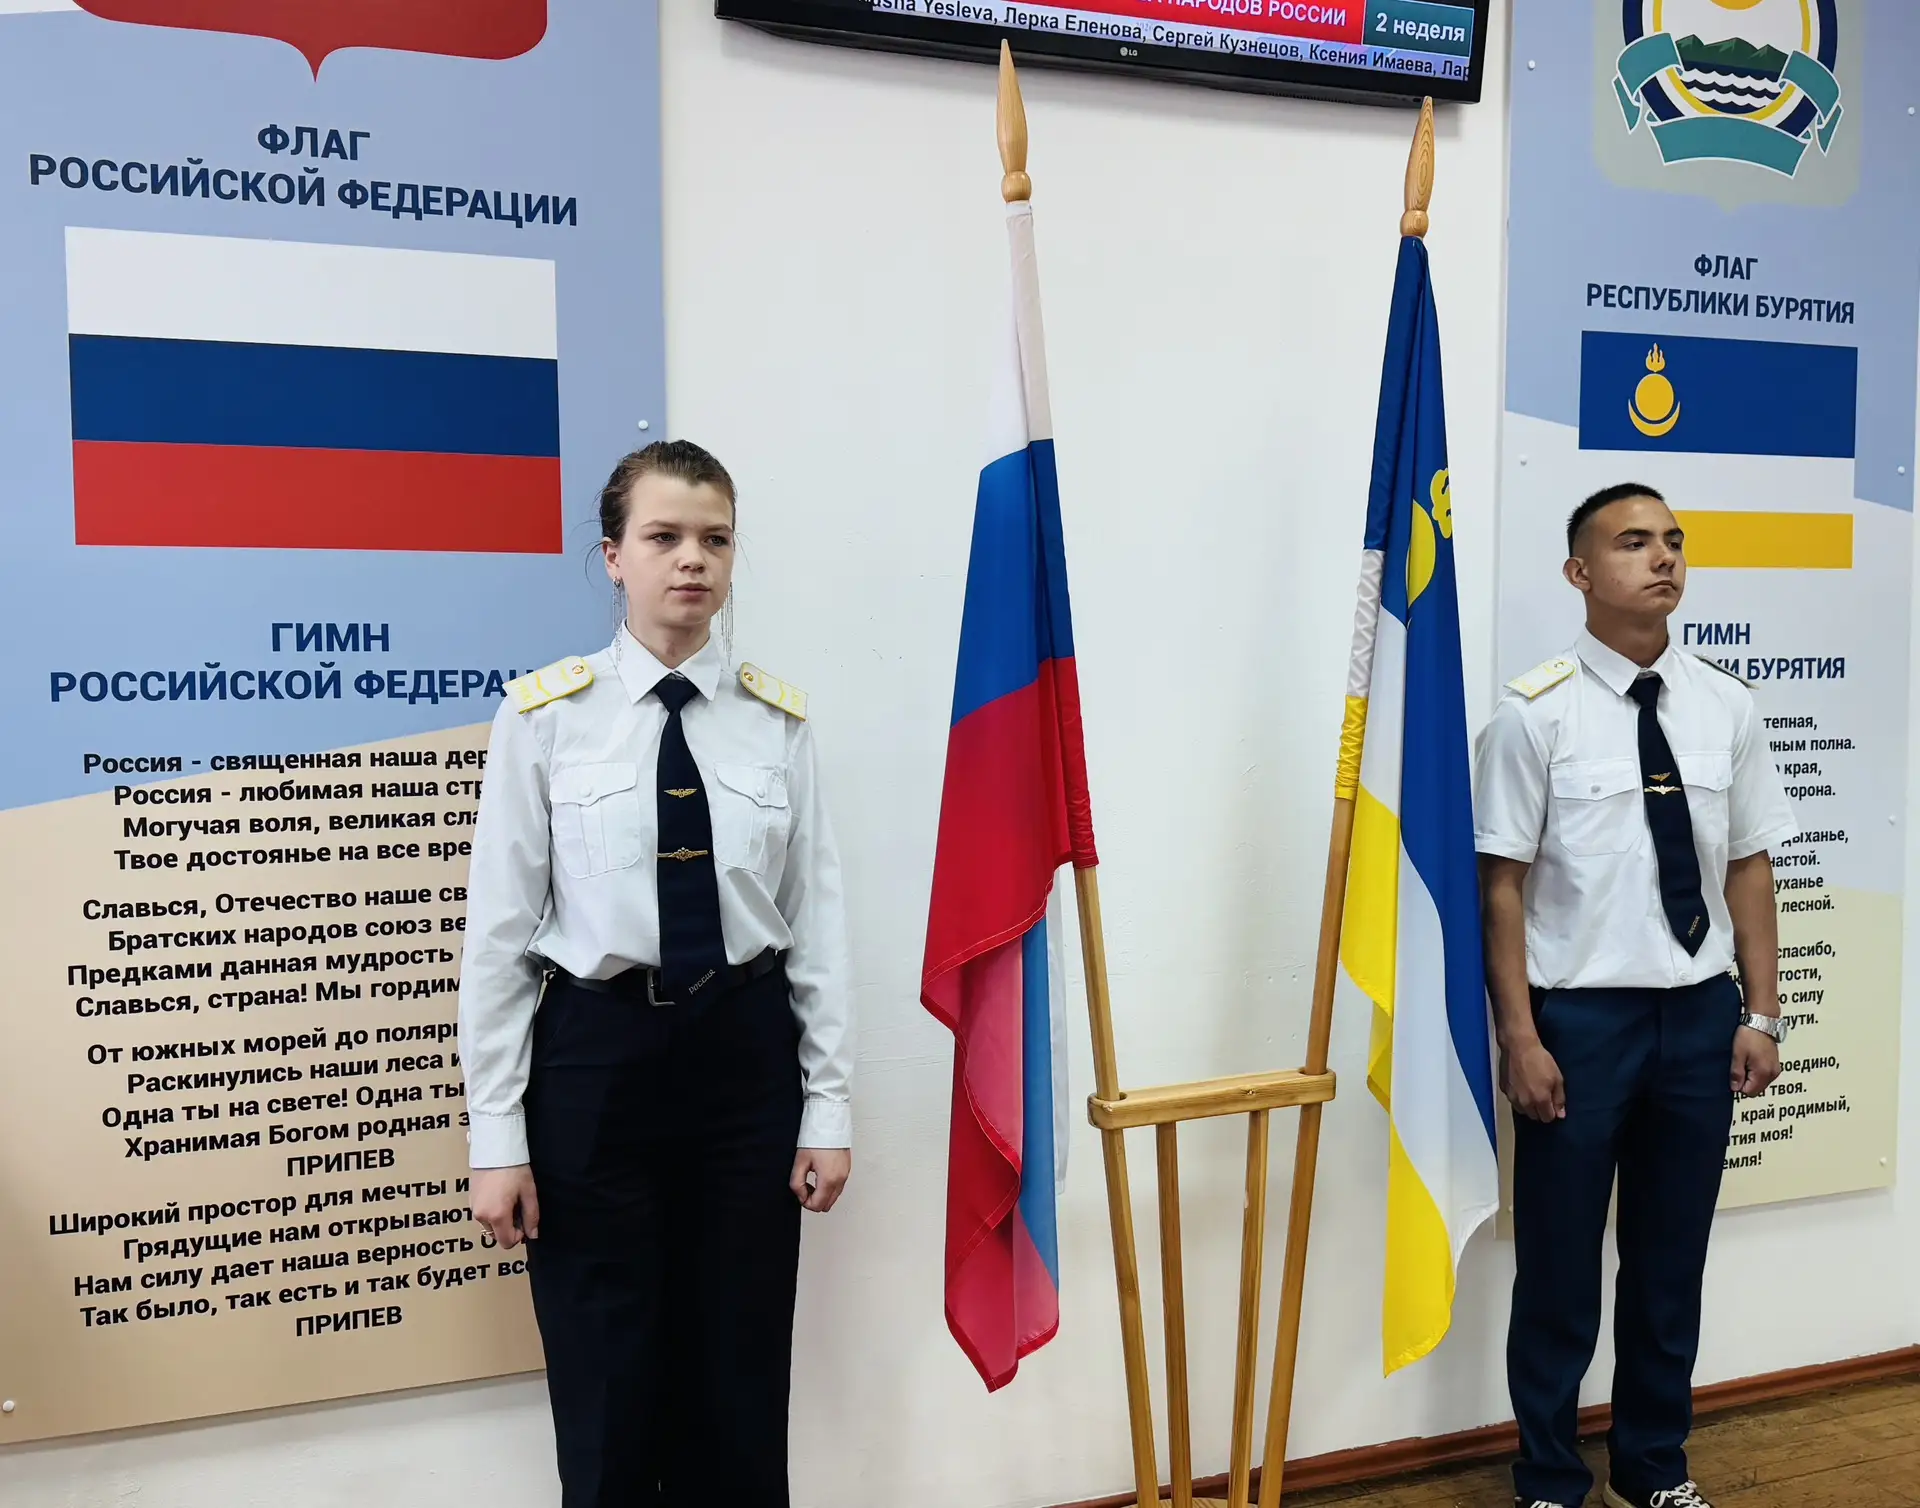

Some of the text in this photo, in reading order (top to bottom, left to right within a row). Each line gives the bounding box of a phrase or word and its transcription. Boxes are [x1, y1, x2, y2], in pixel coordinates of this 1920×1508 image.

[1168, 0, 1346, 27] ОДОВ РОССИИ
[1376, 12, 1466, 43] 2 неделя
[1003, 6, 1059, 31] Лерка
[1065, 14, 1148, 43] Еленова,
[1153, 25, 1214, 48] Сергей
[1220, 30, 1304, 60] Кузнецов,
[1309, 43, 1368, 66] Ксения
[1373, 54, 1437, 77] Имаева,
[1442, 60, 1469, 81] Лар
[257, 123, 371, 161] ФЛАГ
[29, 153, 577, 229] РОССИЙСКОЙ ФЕДЕРАЦИИ
[1694, 253, 1759, 281] ФЛАГ
[1586, 283, 1855, 325] РЕСПУБЛИКИ БУРЯТИЯ
[271, 622, 390, 652] ГИМН
[1683, 622, 1751, 646] ГИМН
[50, 661, 534, 705] РОССИЙСКОЙ ФЕДЕРА
[1746, 657, 1845, 680] БУРЯТИЯ
[1763, 716, 1818, 731] тепная,
[1769, 738, 1856, 752] ным полна.
[83, 753, 182, 774] Россия
[210, 752, 362, 774] священная
[370, 751, 438, 767] наша
[444, 749, 488, 770] дер
[1784, 762, 1822, 779] края,
[114, 785, 212, 806] Россия
[239, 779, 363, 802] любимая
[371, 781, 439, 798] наша
[446, 780, 483, 800] стр
[1783, 784, 1836, 801] торона.
[123, 810, 479, 843] Могучая воля, великая сла
[113, 841, 472, 872] Твое достоянье на все вре
[1774, 876, 1824, 895] уханье
[83, 886, 468, 920] Славься, Отечество наше св
[1780, 894, 1835, 913] лесной.
[108, 916, 467, 953] Братских народов союз ве
[67, 962, 213, 988] Предками
[220, 956, 317, 981] данная
[326, 948, 454, 974] мудрость
[1779, 967, 1822, 982] гости,
[75, 977, 461, 1018] Славься, страна! Мы гордим
[1791, 989, 1824, 1005] силу
[87, 1022, 458, 1065] От южных морей до поляр
[127, 1066, 303, 1094] Раскинулись
[310, 1059, 379, 1080] наши
[385, 1054, 444, 1073] леса
[1769, 1082, 1807, 1096] твоя.
[102, 1081, 465, 1131] Одна ты на свете! Одна ты
[1741, 1103, 1775, 1125] край
[1778, 1095, 1850, 1122] родимый,
[124, 1131, 261, 1160] Хранимая
[269, 1123, 349, 1145] Богом
[357, 1113, 450, 1142] родная
[1726, 1124, 1793, 1147] тия моя!
[287, 1148, 395, 1177] ПРИПЕВ
[1722, 1151, 1762, 1170] емля!
[49, 1177, 470, 1236] Широкий простор для мечты и
[123, 1207, 473, 1264] Грядущие нам открывают
[74, 1275, 132, 1297] Нам
[140, 1267, 204, 1293] силу
[210, 1259, 275, 1286] дает
[281, 1251, 350, 1273] наша
[357, 1237, 474, 1266] верность
[79, 1260, 529, 1327] Так было, так есть и так будет вс
[296, 1305, 403, 1337] ПРИПЕВ
